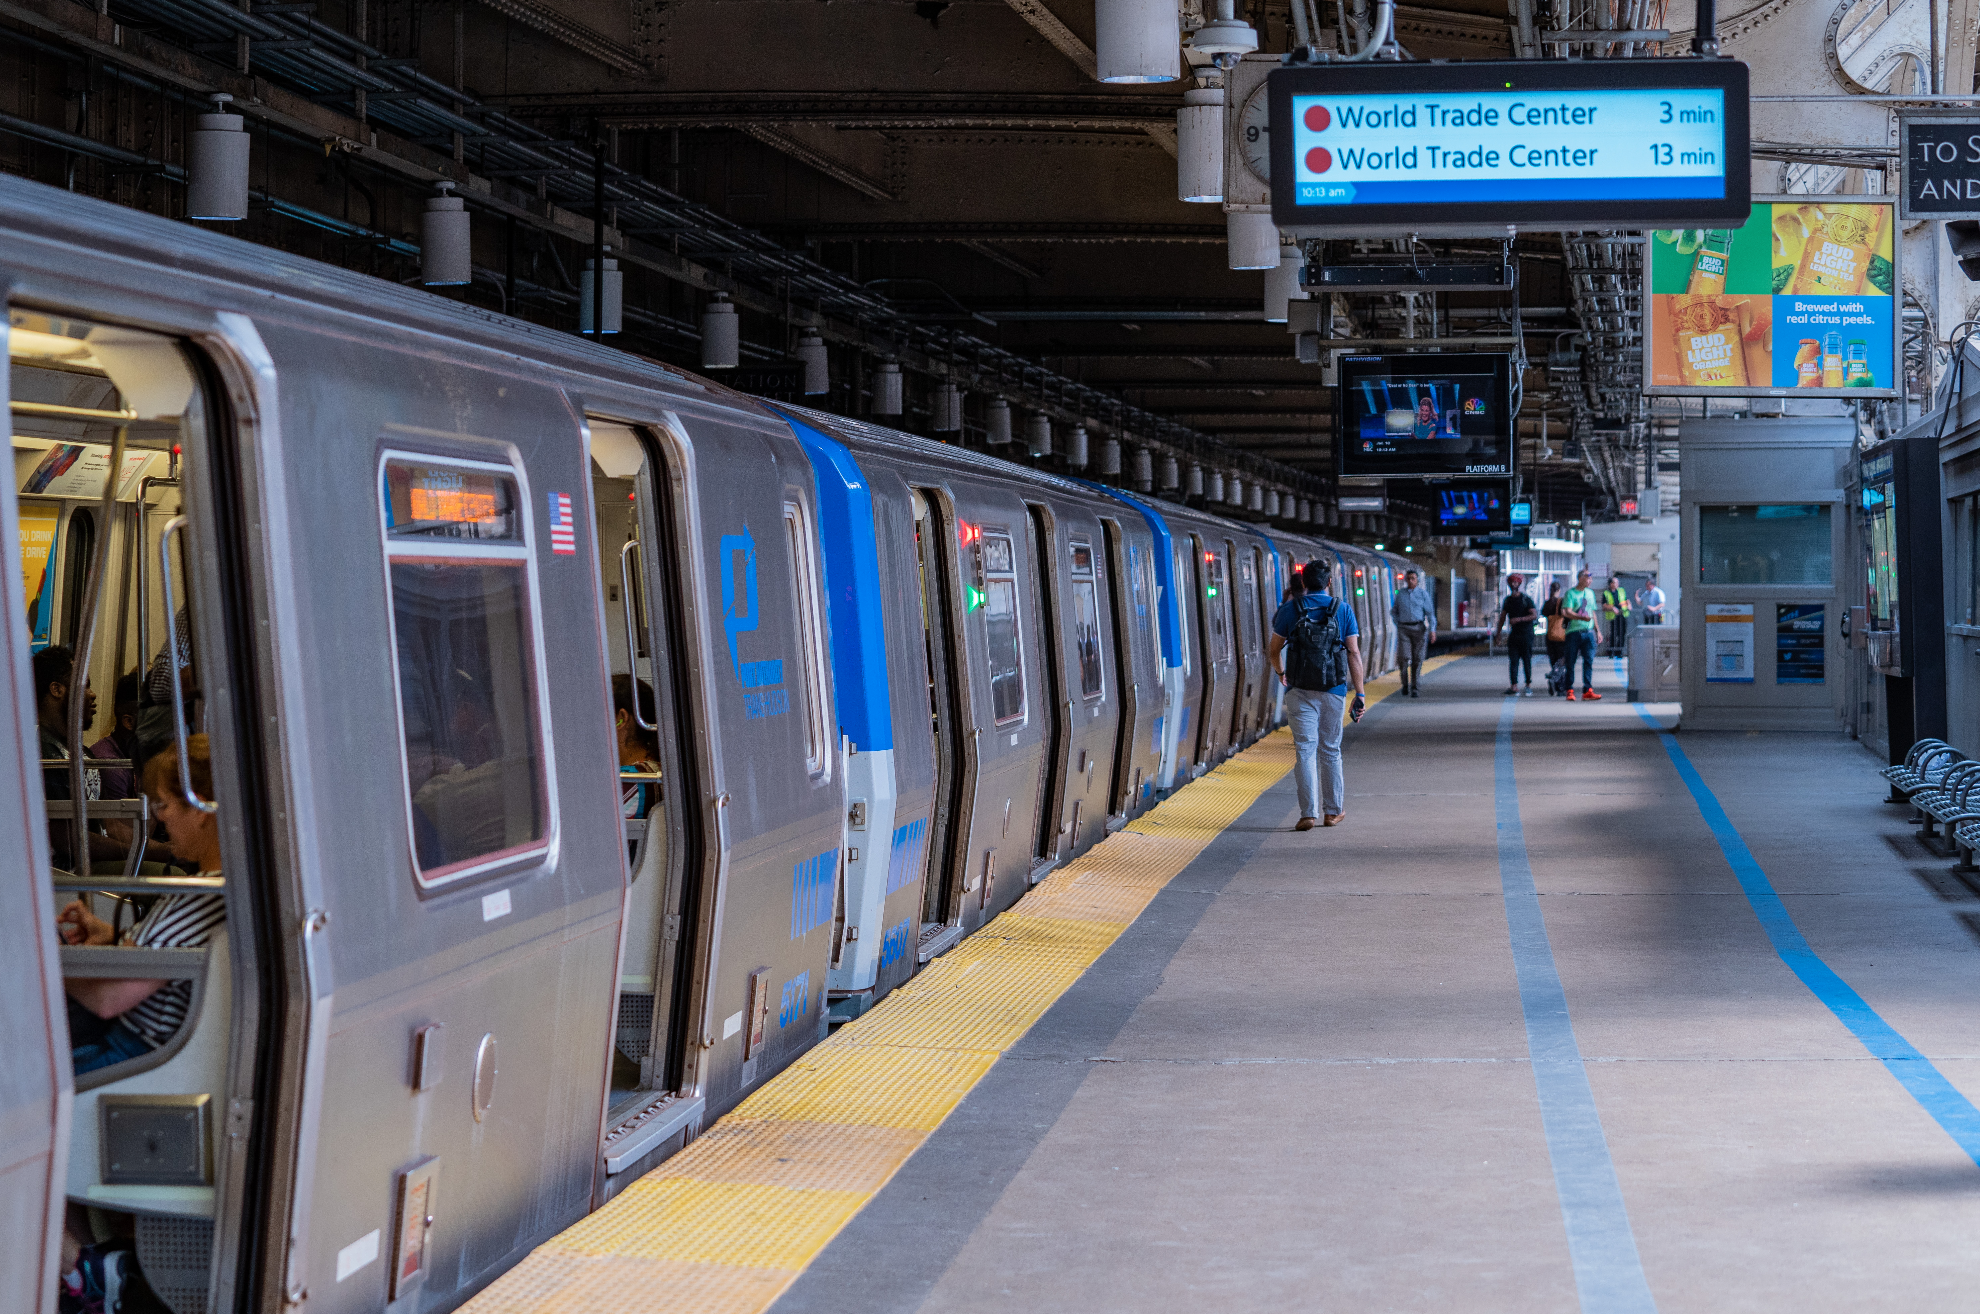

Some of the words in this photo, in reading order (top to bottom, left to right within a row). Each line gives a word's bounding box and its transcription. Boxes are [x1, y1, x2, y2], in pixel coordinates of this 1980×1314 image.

[1336, 103, 1417, 129] World
[1425, 103, 1499, 127] Trade
[1507, 101, 1599, 126] Center
[1659, 101, 1673, 124] 3
[1680, 105, 1715, 124] min
[1246, 126, 1260, 142] 9
[1338, 146, 1418, 171] World
[1426, 145, 1500, 170] Trade
[1508, 143, 1599, 168] Center
[1649, 143, 1674, 166] 13
[1680, 147, 1716, 166] min
[1918, 142, 1957, 163] TO
[1302, 187, 1325, 198] 10:13
[1328, 188, 1345, 198] am
[1919, 178, 1980, 200] AND
[1703, 255, 1722, 265] BUD
[1822, 242, 1854, 260] BUD
[1697, 262, 1724, 274] LIGHT
[1813, 251, 1857, 273] LIGHT
[1810, 263, 1838, 277] LEMON
[1839, 271, 1854, 281] TEA
[1795, 302, 1838, 313] Brewed
[1839, 302, 1864, 313] with
[1787, 313, 1807, 324] real
[1810, 314, 1841, 325] citrus
[1842, 314, 1875, 326] peels.
[1690, 333, 1725, 350] BUD
[1687, 344, 1733, 363] LIGHT
[1692, 358, 1730, 370] ORANGE
[1466, 465, 1499, 473] PLATFORM
[31, 530, 52, 542] DRINK
[26, 547, 46, 558] DRIVE
[881, 917, 911, 969] 5607
[780, 968, 810, 1028] 5171
